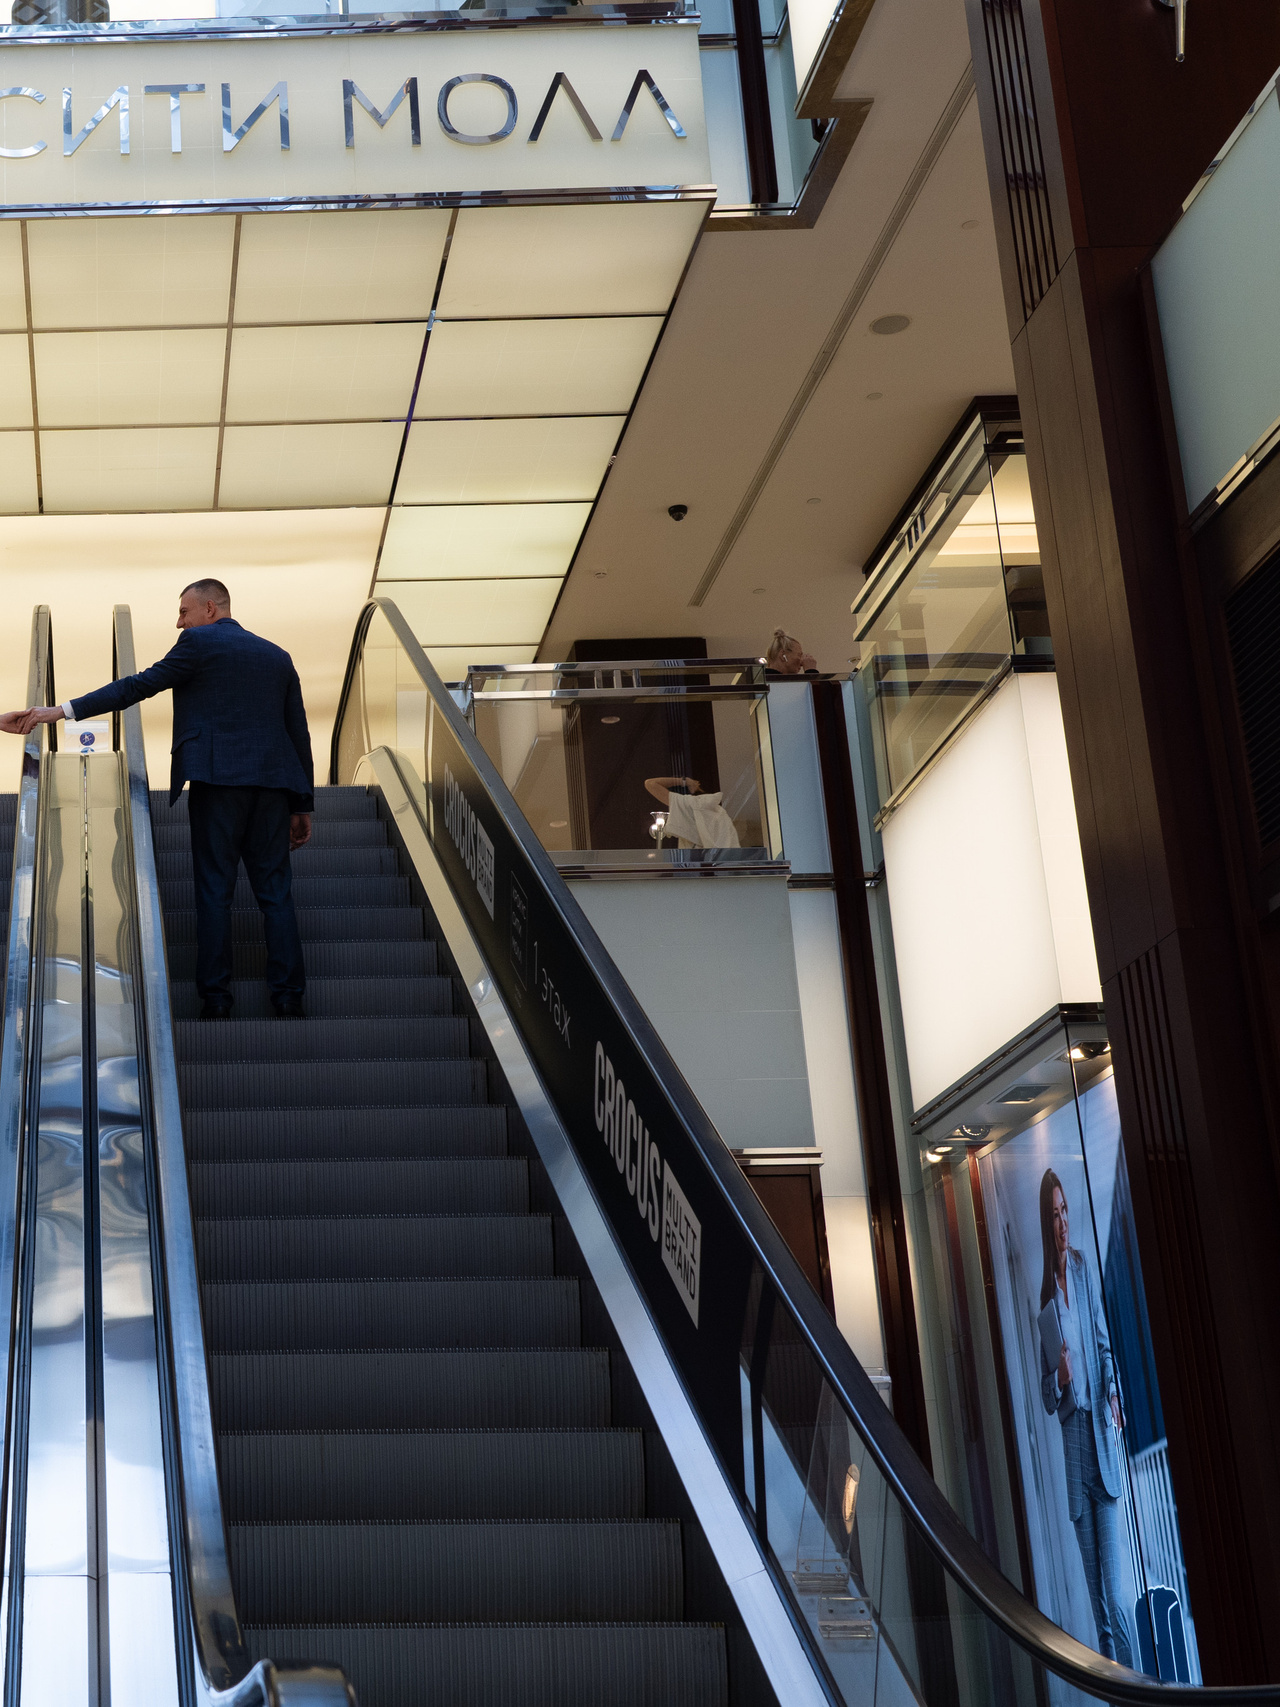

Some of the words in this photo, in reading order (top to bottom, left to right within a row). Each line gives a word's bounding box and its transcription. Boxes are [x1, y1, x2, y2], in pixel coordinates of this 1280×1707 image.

[342, 68, 688, 150] МОЛЛ
[443, 762, 477, 881] CROCUS
[533, 940, 539, 985] 1
[541, 967, 571, 1050] этаж
[594, 1040, 661, 1243] CROCUS
[665, 1218, 697, 1302] BRAND
[666, 1181, 698, 1264] MULTI
